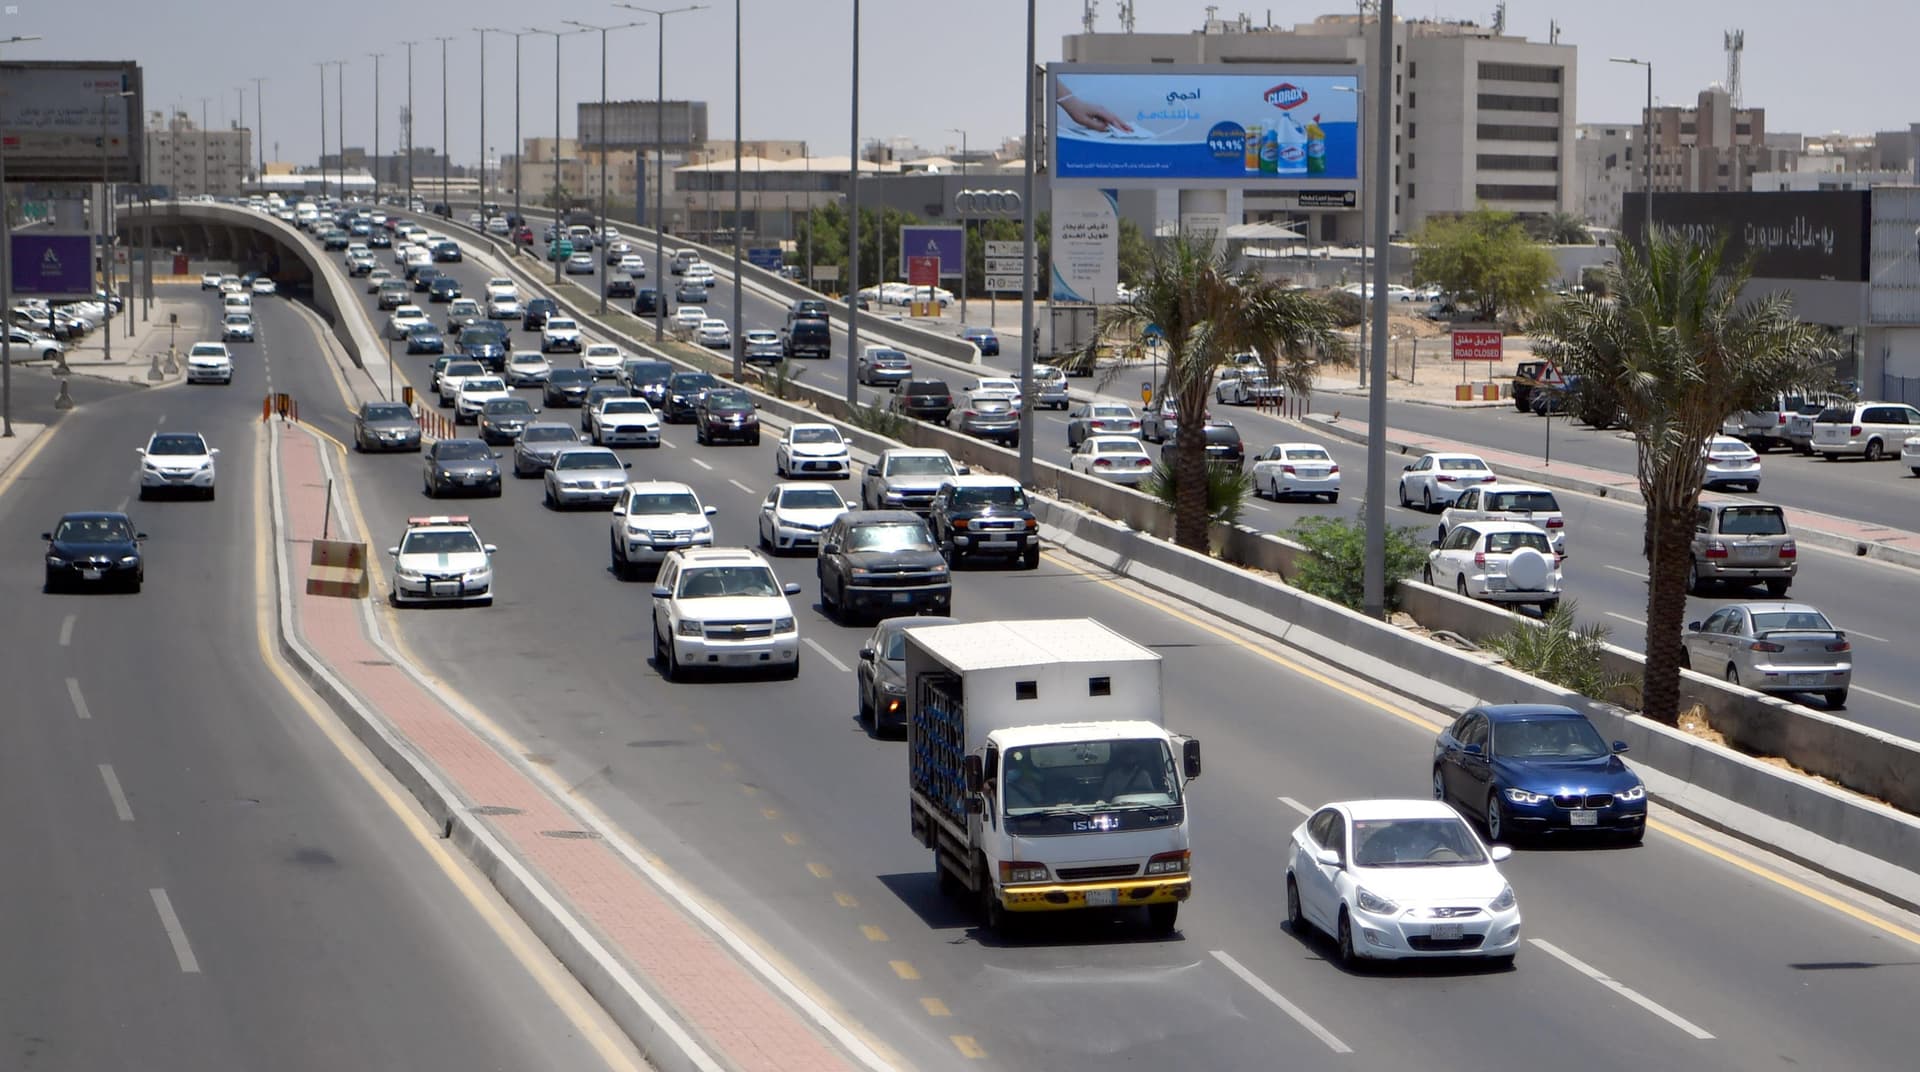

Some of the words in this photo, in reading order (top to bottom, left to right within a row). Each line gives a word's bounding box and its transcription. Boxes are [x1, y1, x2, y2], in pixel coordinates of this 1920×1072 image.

[1268, 88, 1304, 105] CLOROX
[1474, 336, 1499, 346] الطريق
[1455, 348, 1473, 357] ROAD
[1474, 348, 1499, 357] CLOSED
